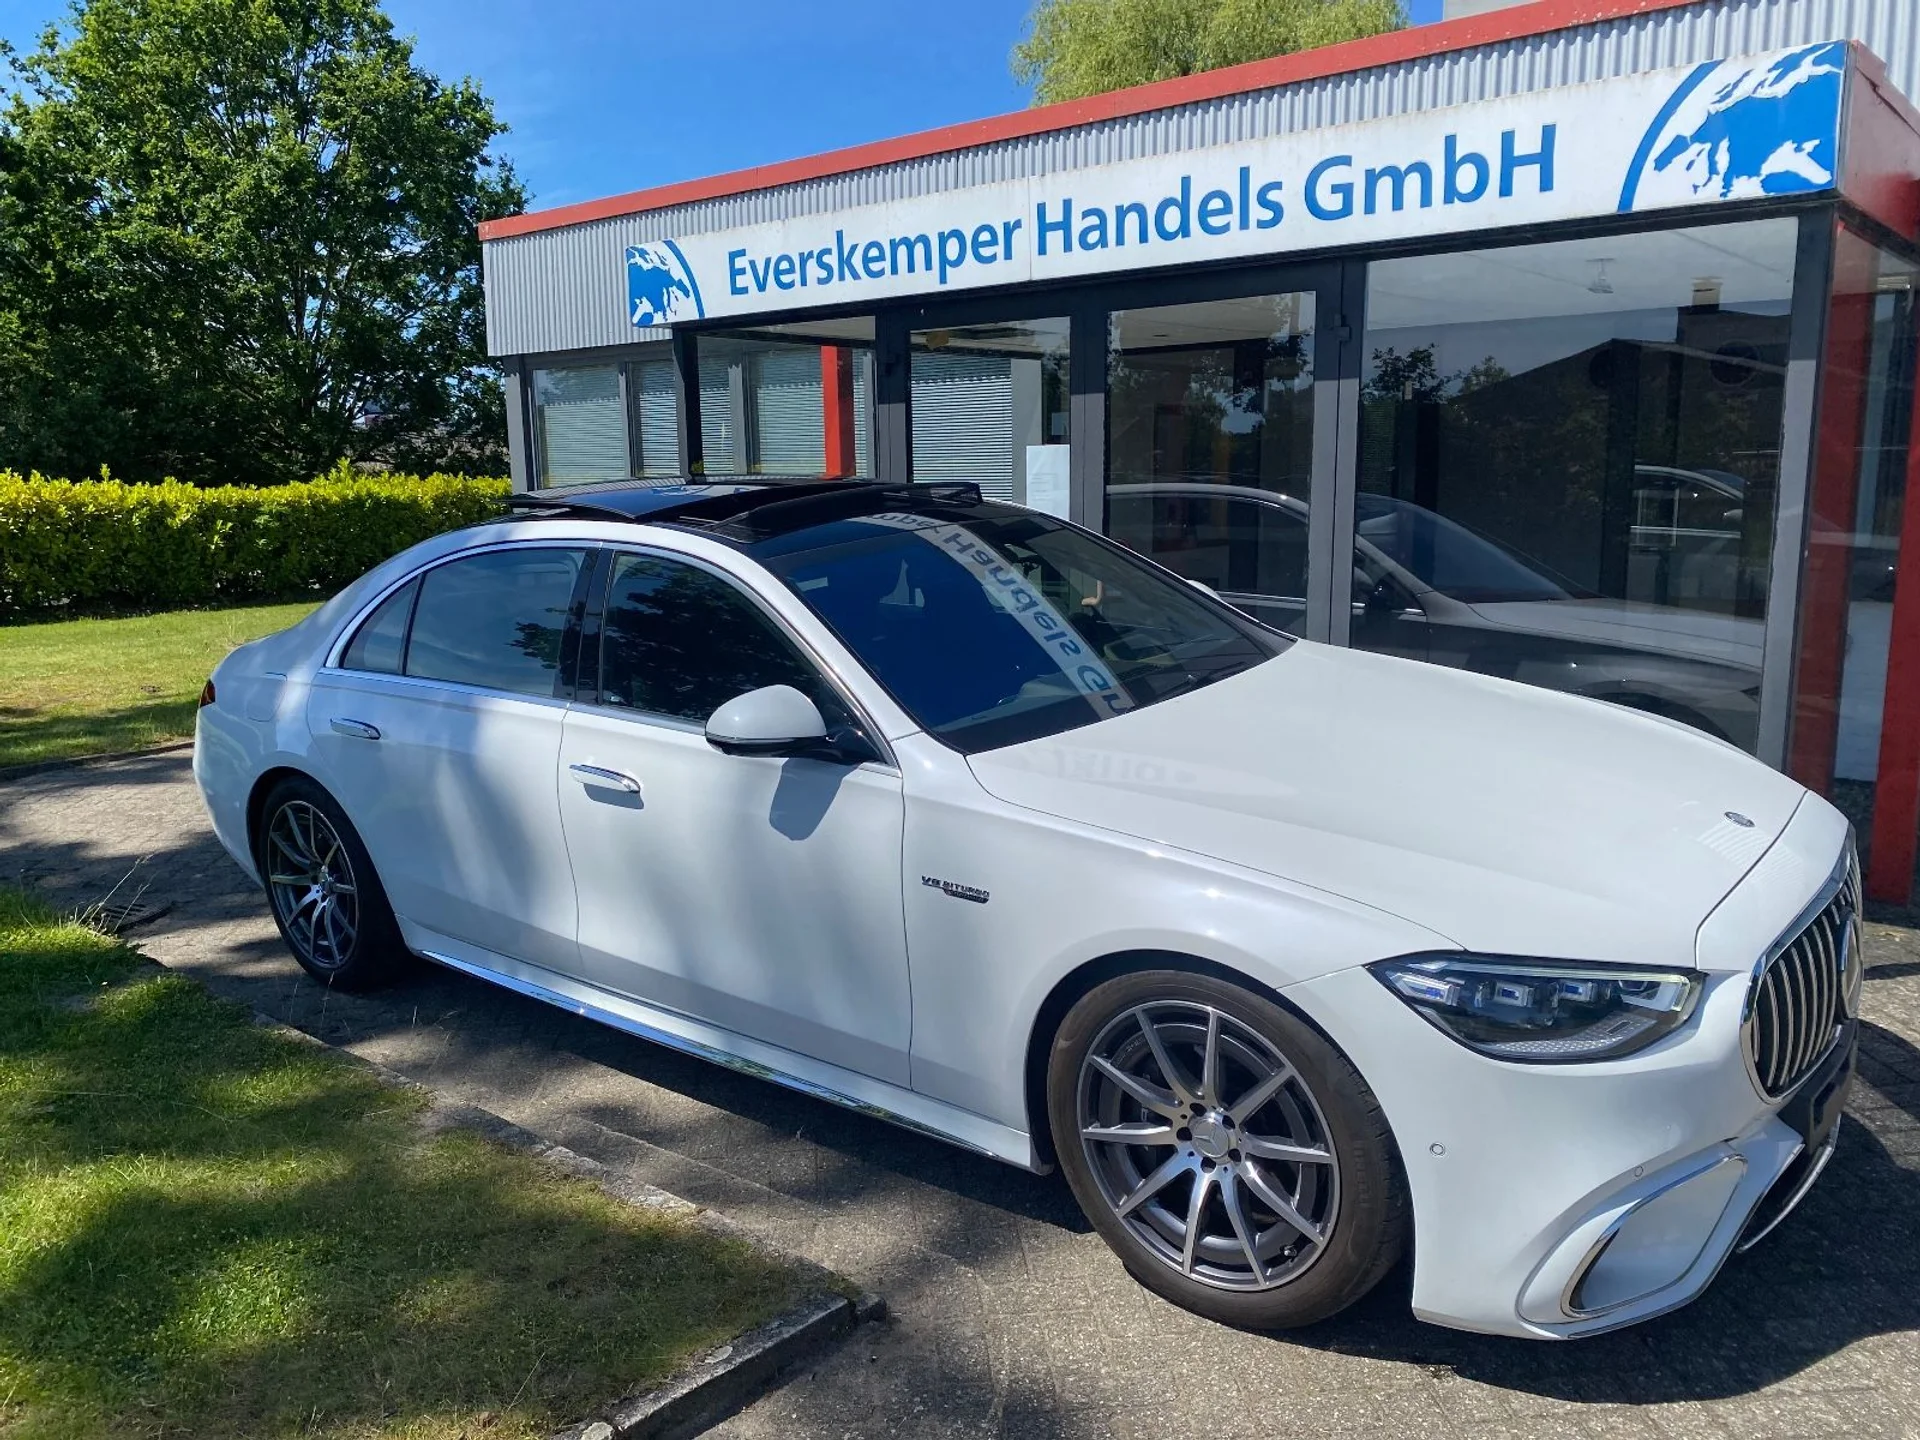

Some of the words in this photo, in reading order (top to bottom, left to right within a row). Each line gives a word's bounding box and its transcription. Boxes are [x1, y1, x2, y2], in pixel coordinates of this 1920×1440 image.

[728, 218, 1023, 297] Everskemper
[1037, 165, 1285, 257] Handels
[1303, 124, 1557, 222] GmbH
[942, 880, 990, 899] BITURBO
